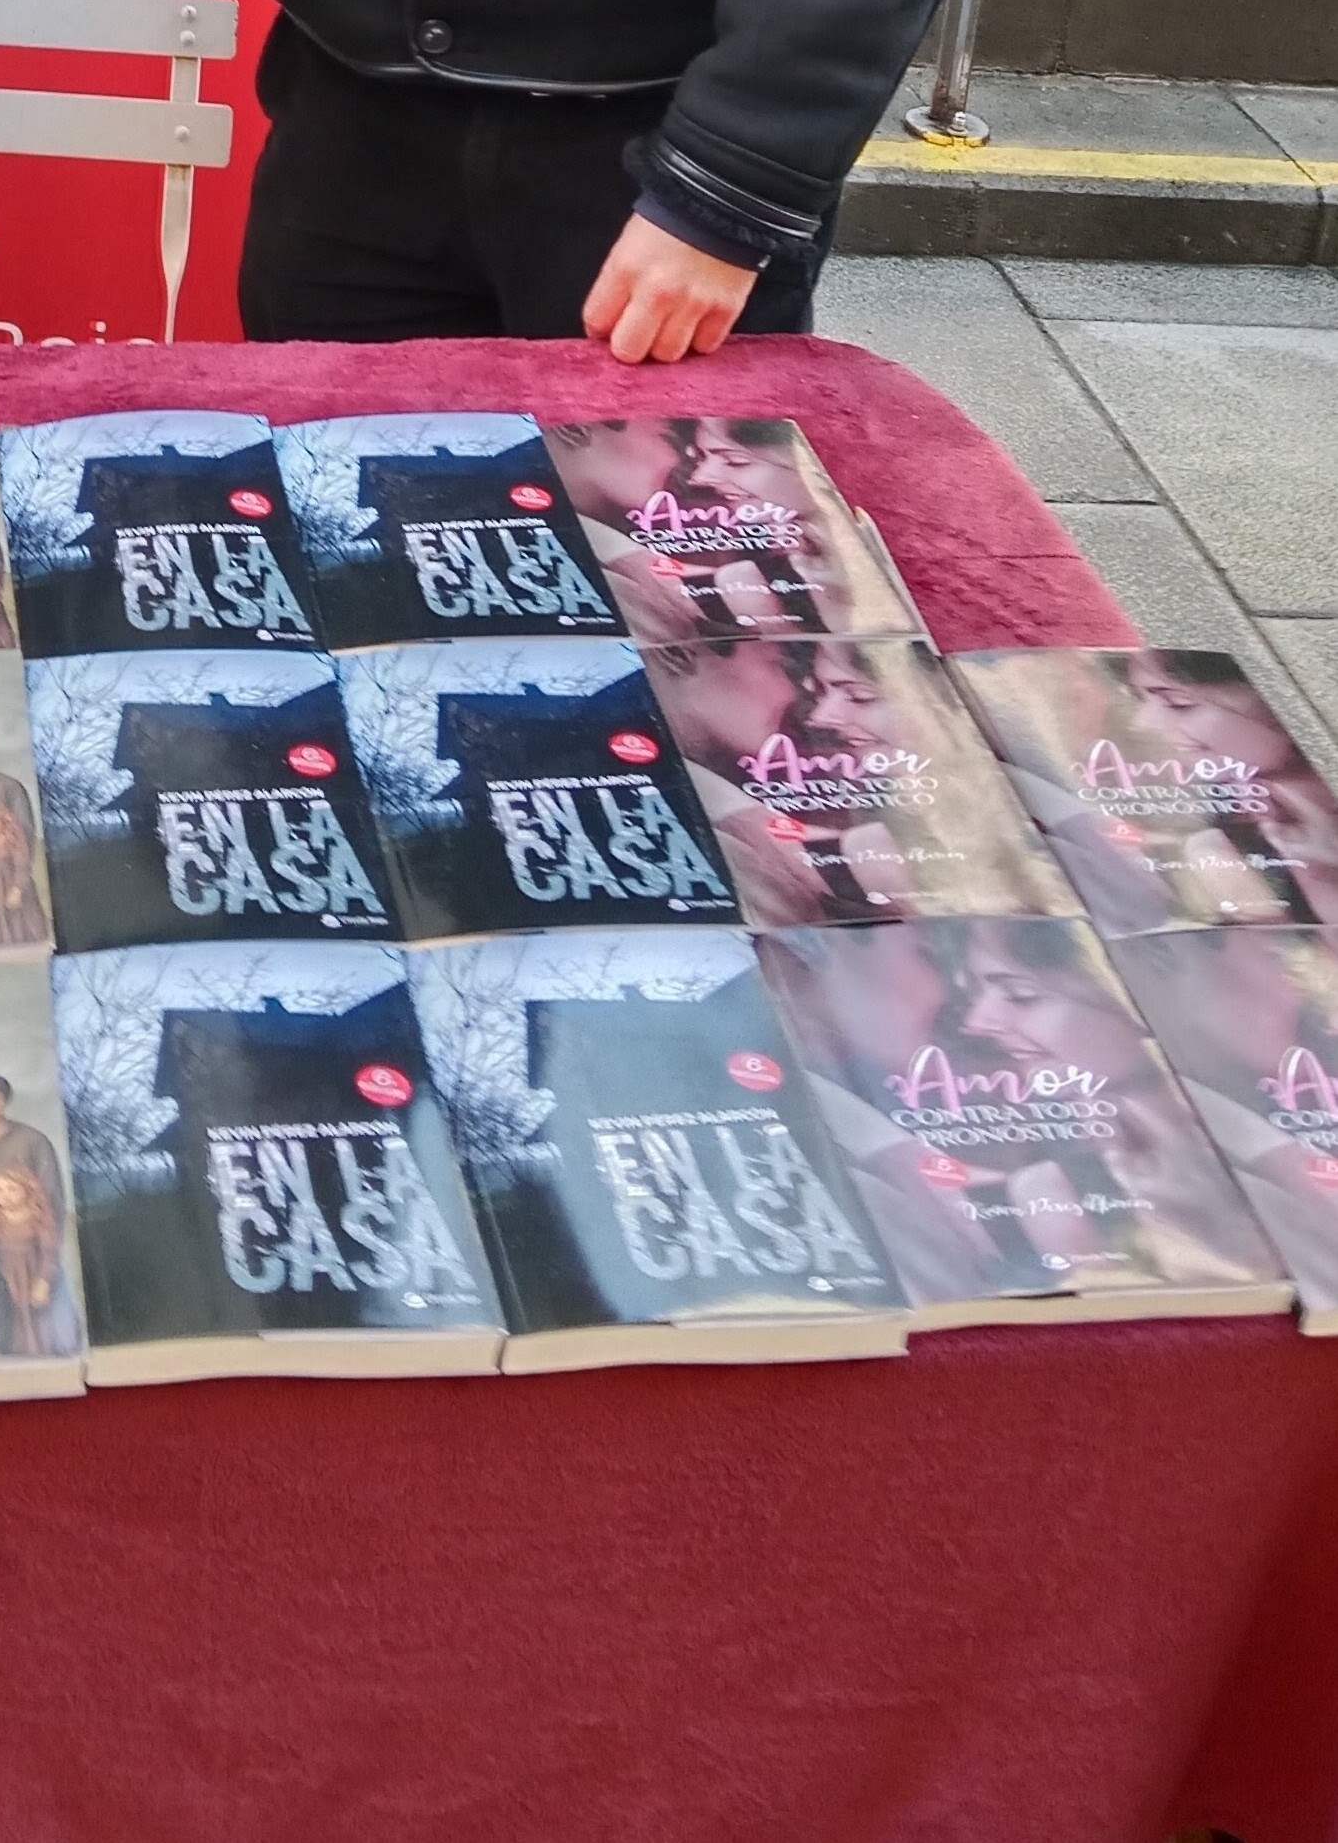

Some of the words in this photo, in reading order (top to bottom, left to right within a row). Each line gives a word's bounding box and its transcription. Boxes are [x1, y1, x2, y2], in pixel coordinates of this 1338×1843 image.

[625, 490, 799, 535] Amor
[630, 526, 732, 544] CONTRA
[735, 523, 803, 537] TODO
[116, 534, 194, 578] EN
[212, 533, 278, 578] LA
[405, 529, 486, 570] EN
[498, 527, 568, 567] LA
[122, 573, 312, 632] CASA
[417, 564, 613, 618] CASA
[737, 733, 931, 793] Amor
[741, 779, 860, 797] CONTRA
[862, 776, 938, 792] TODO
[1070, 739, 1260, 796] Amor
[490, 789, 583, 840] EN
[596, 786, 678, 837] LA
[1078, 785, 1191, 801] CONTRA
[1196, 783, 1270, 799] TODO
[157, 801, 249, 853] EN
[267, 800, 345, 851] LA
[165, 846, 386, 915] CASA
[504, 832, 731, 902] CASA
[883, 1045, 1108, 1121] Amor
[890, 1104, 1025, 1127] CONTRA
[1028, 1100, 1117, 1119] TODO
[207, 1140, 314, 1208] EN
[334, 1137, 426, 1205] LA
[593, 1129, 698, 1197] EN
[716, 1124, 812, 1190] LA
[218, 1202, 478, 1293] CASA
[613, 1188, 879, 1280] CASA
